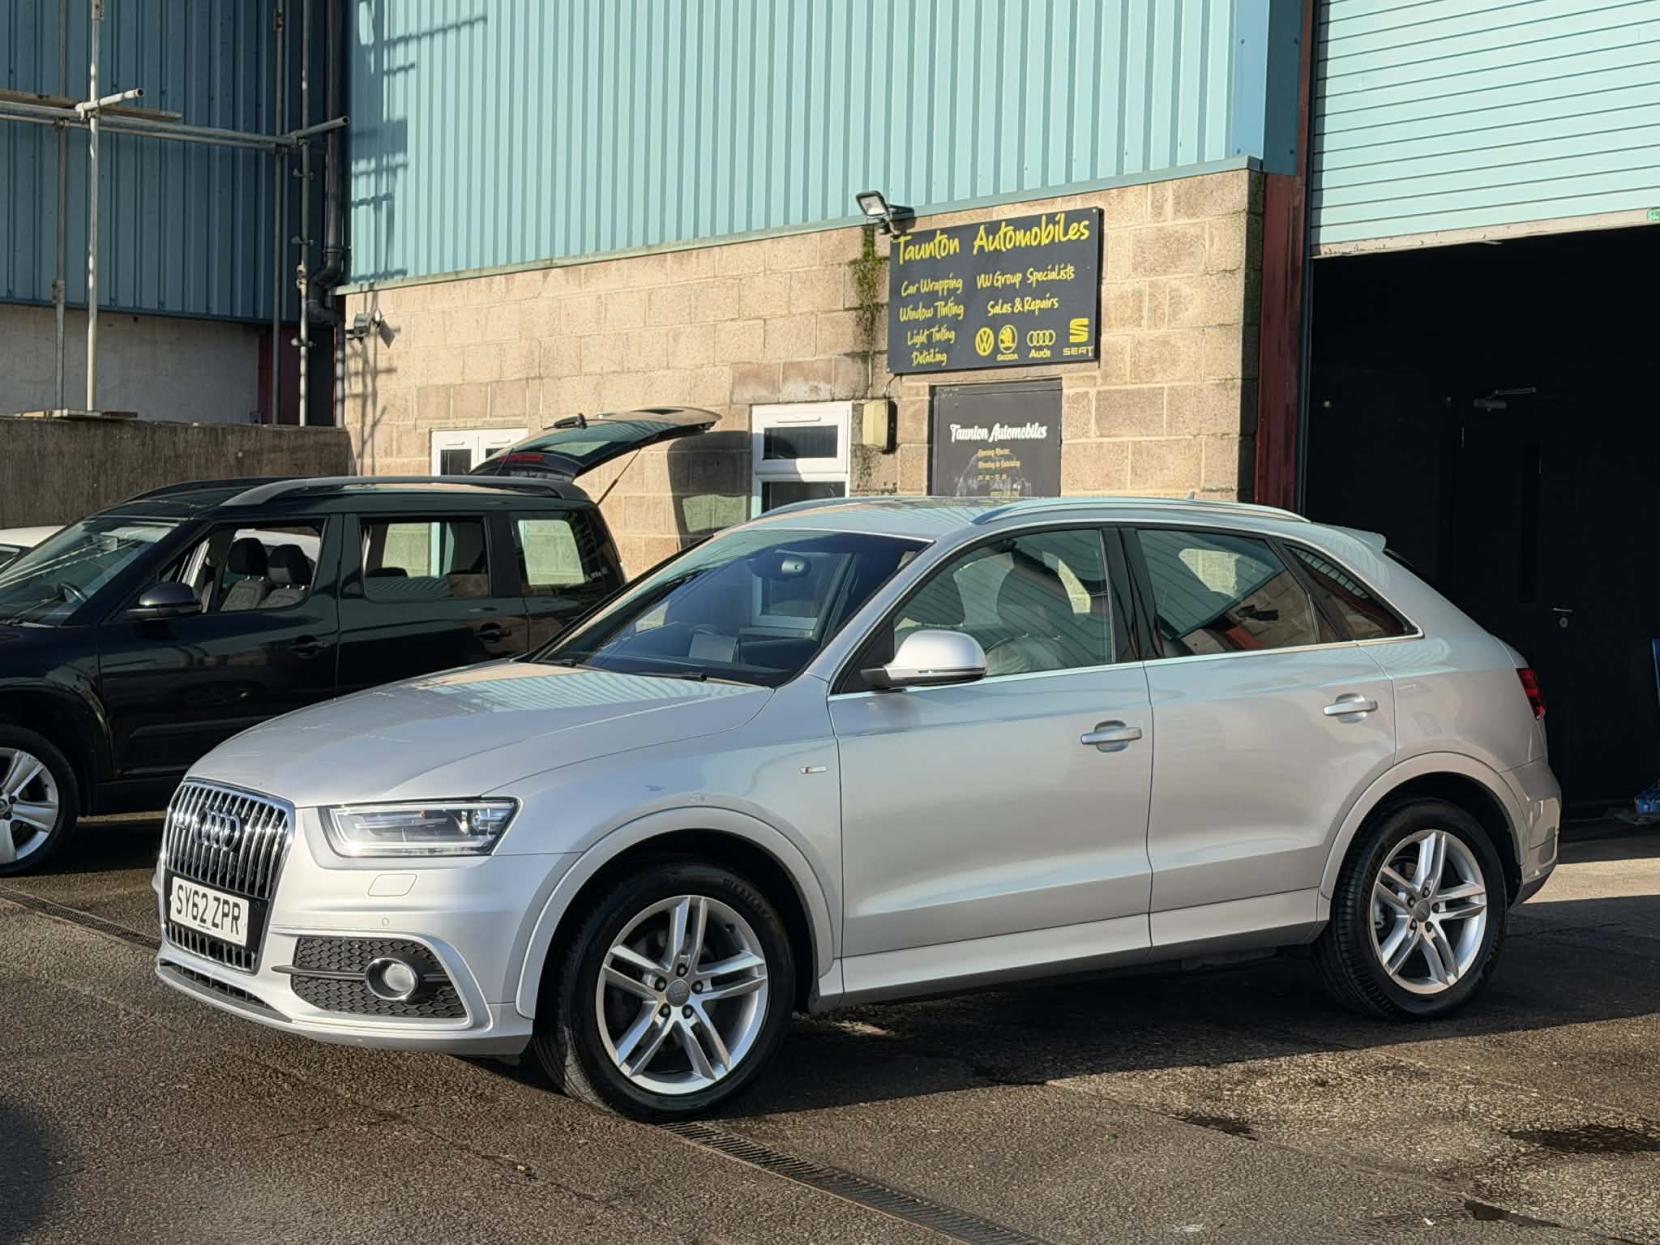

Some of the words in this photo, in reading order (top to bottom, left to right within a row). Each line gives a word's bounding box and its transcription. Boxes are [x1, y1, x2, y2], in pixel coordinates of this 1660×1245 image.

[893, 230, 960, 264] Taunton
[973, 213, 1090, 255] Automobiles
[901, 280, 919, 297] Car
[919, 272, 963, 296] Wrapping
[993, 271, 1022, 289] Group
[1026, 264, 1075, 287] Specialists
[899, 301, 934, 322] Window
[934, 297, 964, 320] Tinting
[987, 298, 1012, 317] Sales
[1013, 297, 1023, 313] &
[1024, 293, 1059, 316] Repairs
[907, 330, 930, 348] Light
[930, 324, 956, 344] Tinting
[911, 348, 947, 367] Detailing
[1028, 349, 1051, 358] Audi
[1062, 346, 1094, 357] SEAT
[949, 424, 988, 443] Taunton
[988, 422, 1048, 442] Automobiles
[176, 884, 208, 924] SY62
[211, 897, 241, 935] ZPR
